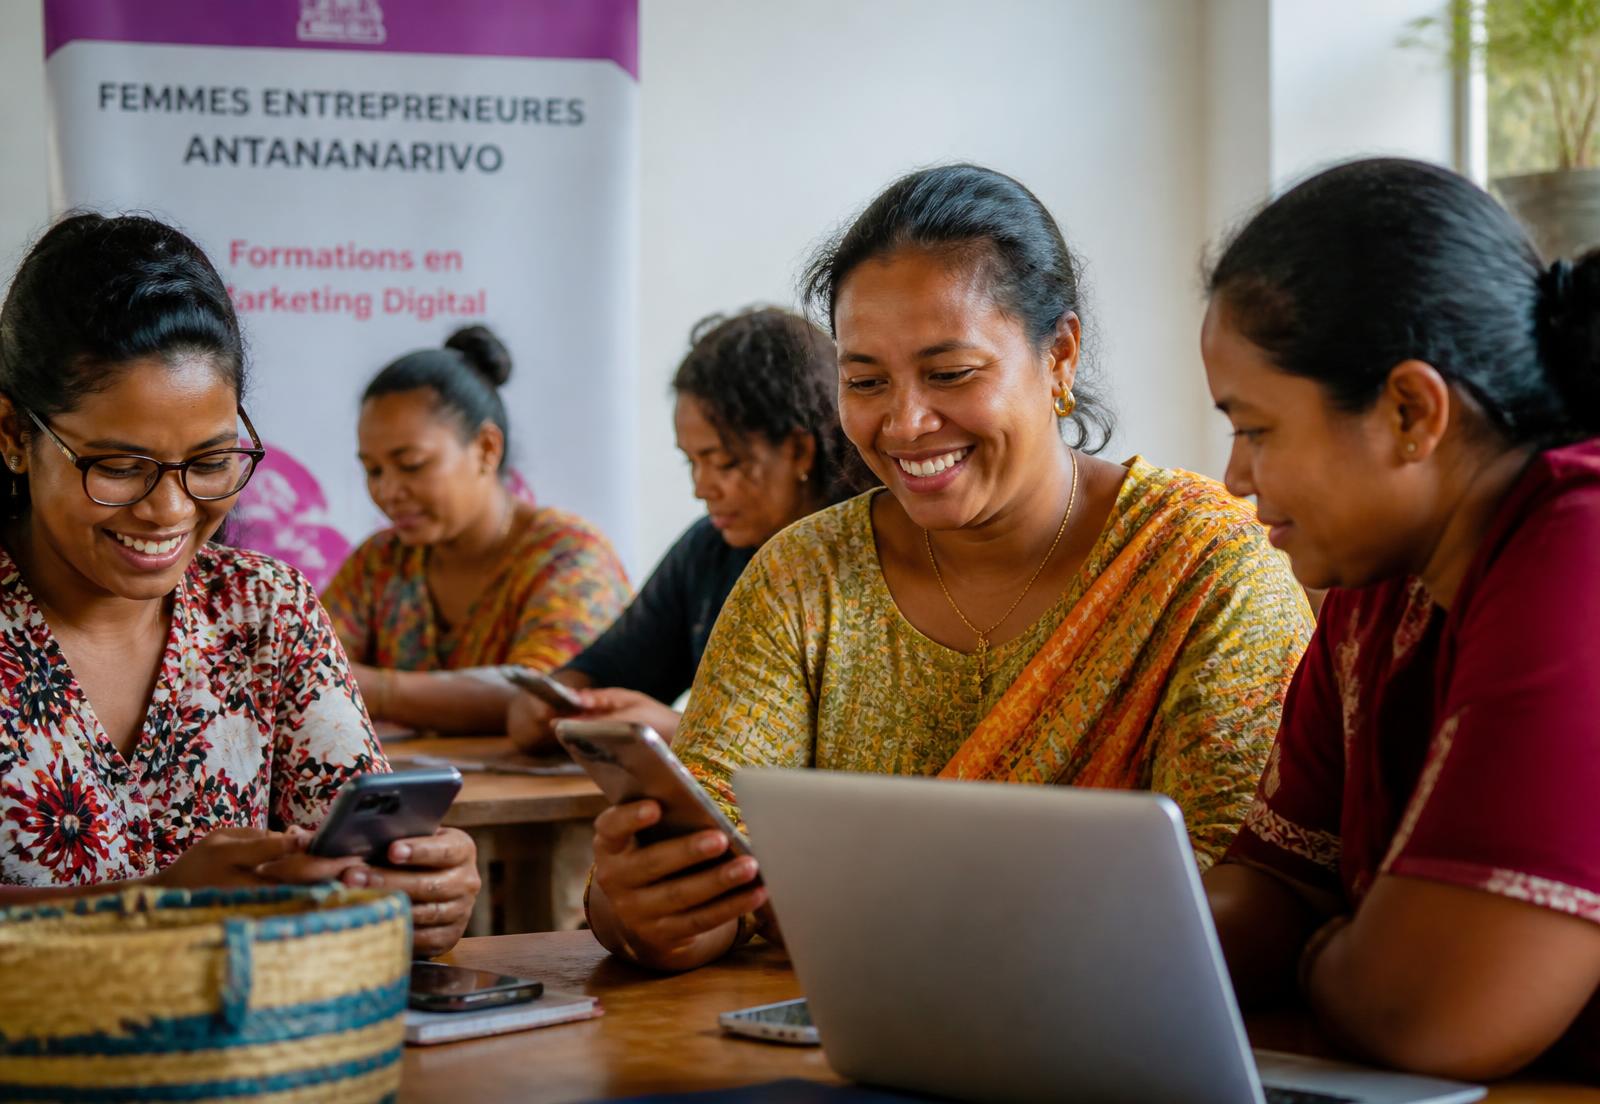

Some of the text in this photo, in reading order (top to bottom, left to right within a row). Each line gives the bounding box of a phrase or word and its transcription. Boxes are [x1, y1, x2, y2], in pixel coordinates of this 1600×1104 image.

[98, 82, 585, 126] FEMMES ENTREPRENEURES
[183, 134, 504, 173] ANTANANARIVO
[229, 240, 463, 272] Formations en
[227, 284, 486, 321] arketing Digital
